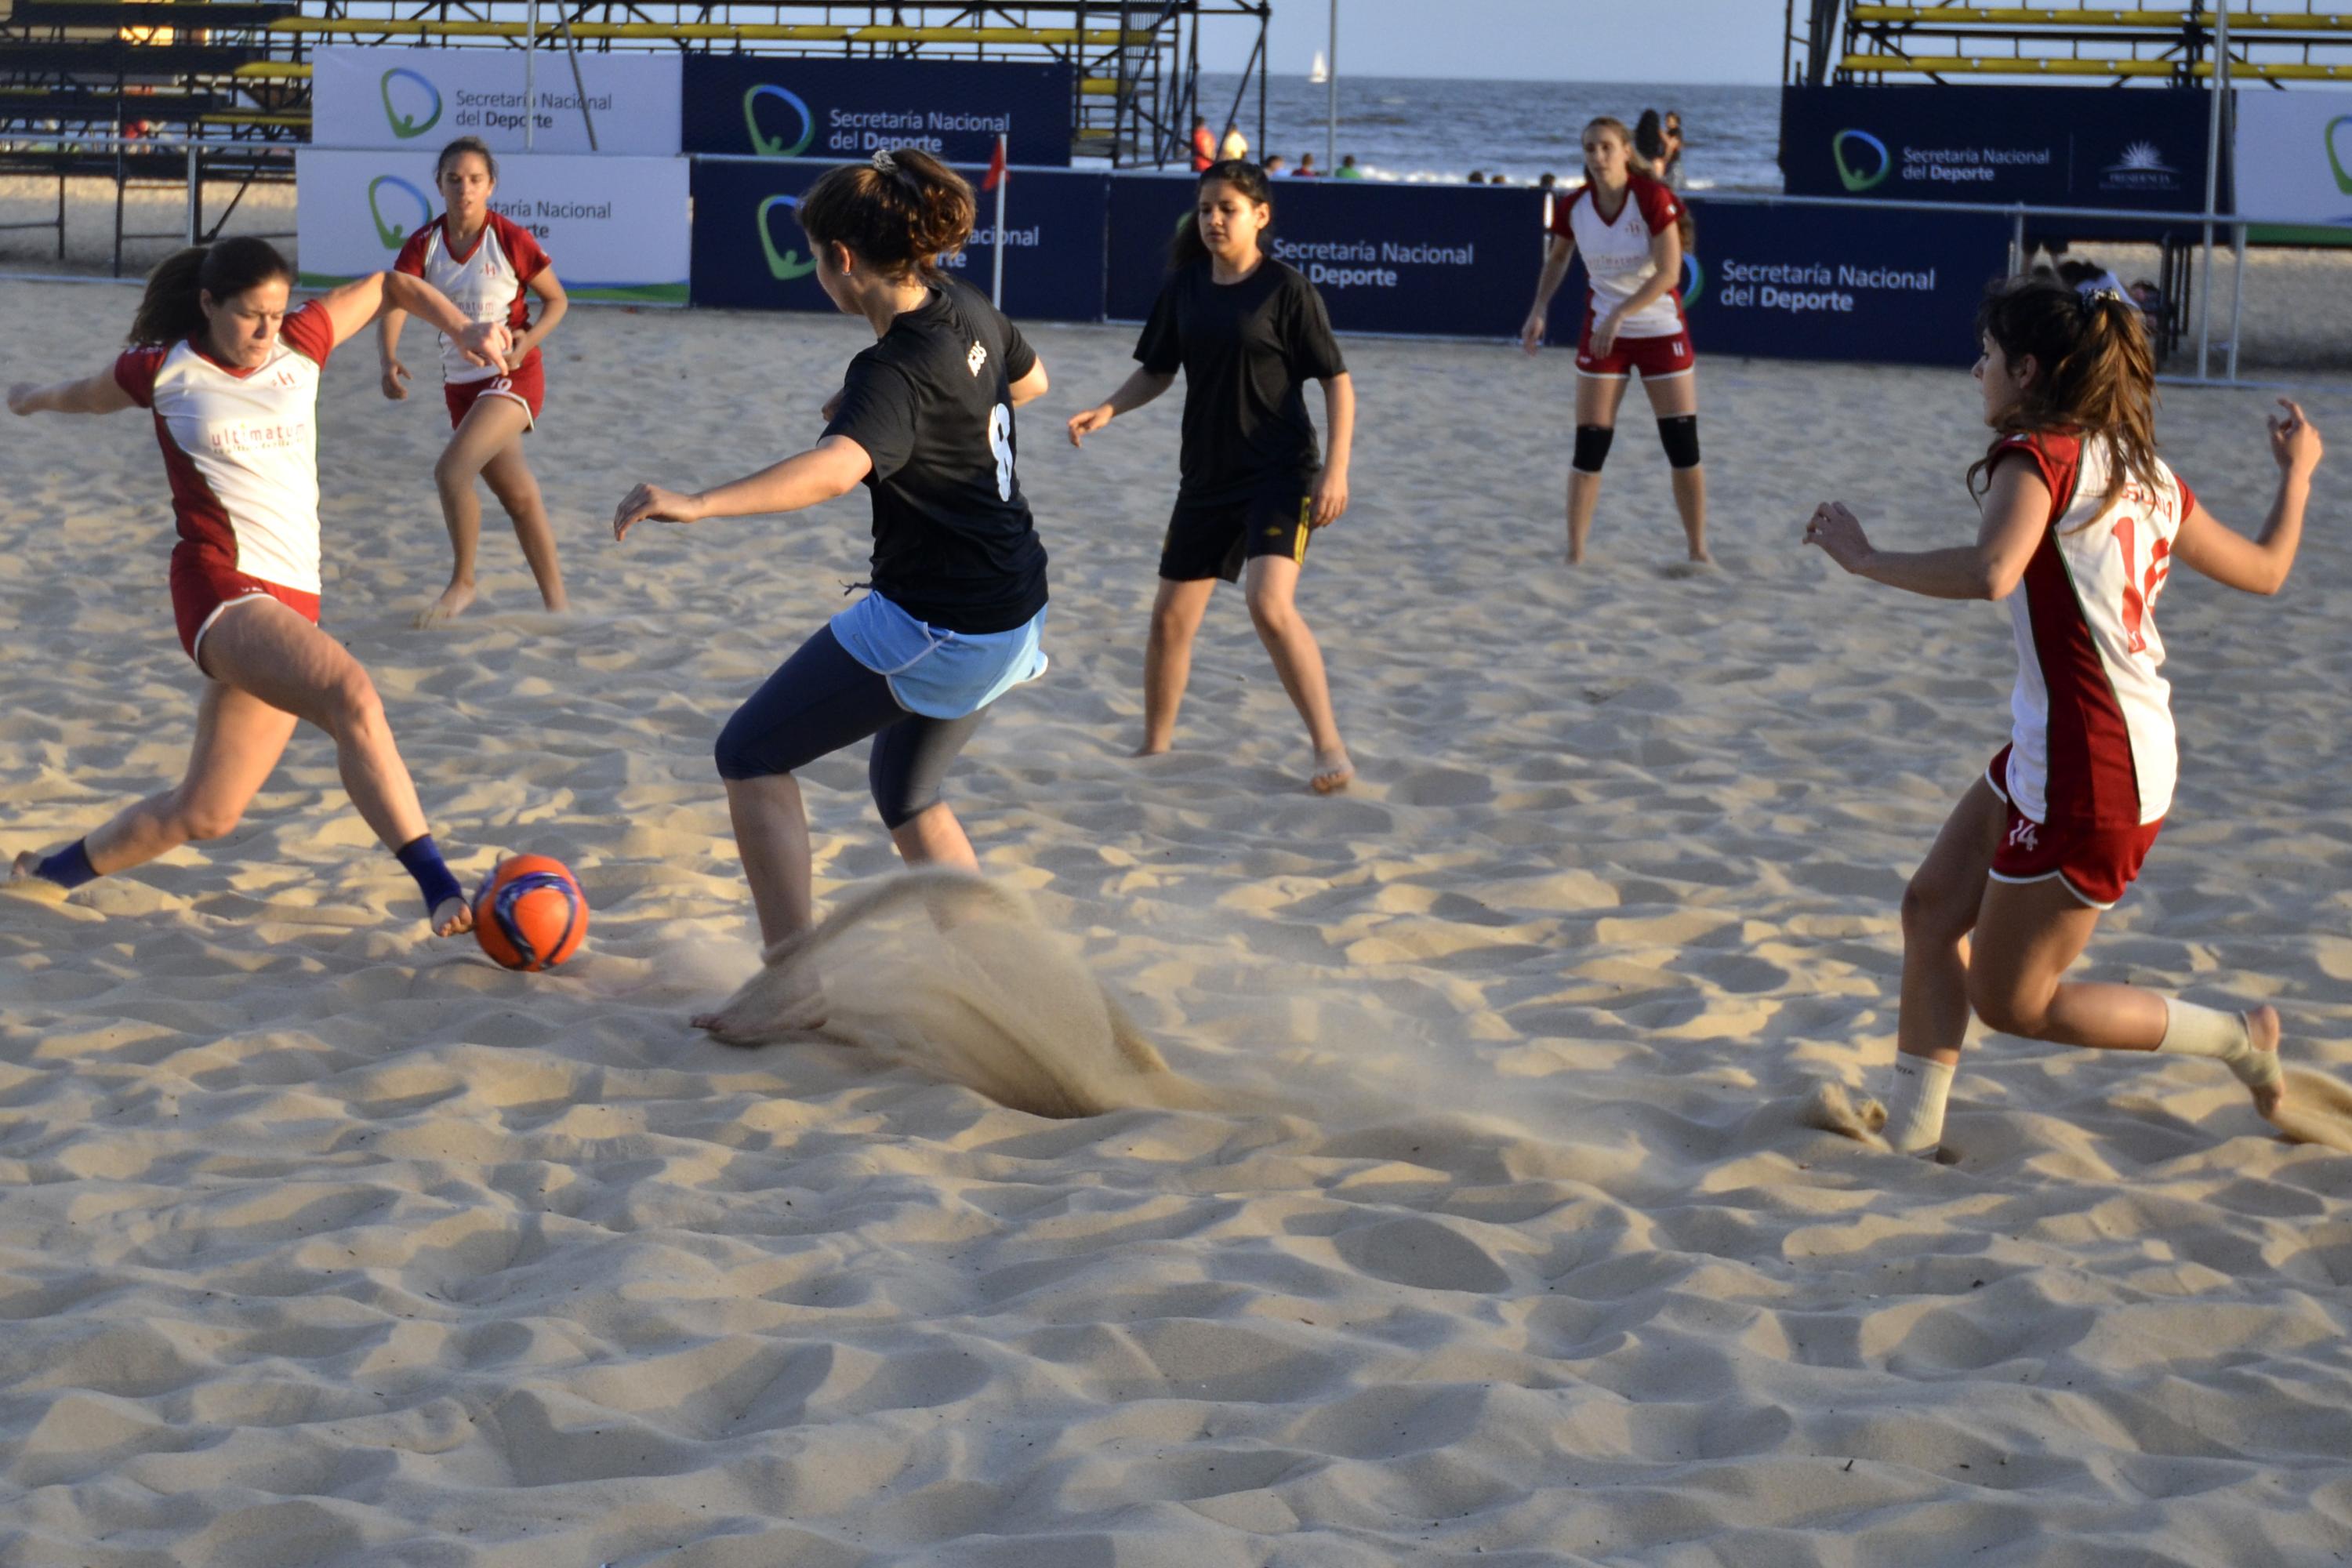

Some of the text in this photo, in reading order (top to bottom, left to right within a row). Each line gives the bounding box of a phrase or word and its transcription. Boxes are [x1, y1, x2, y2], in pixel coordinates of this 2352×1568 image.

[456, 110, 480, 125] del
[829, 109, 1010, 132] Secretaría Nacional
[829, 131, 942, 152] del Deporte
[1903, 146, 2049, 164] Secretaría Nacional
[1903, 165, 1994, 183] del Deporte
[537, 201, 612, 219] Nacional
[1272, 238, 1474, 264] Secretaría Nacional
[1309, 263, 1397, 289] Deporte
[1722, 259, 1935, 290] Secretaría Nacional
[1720, 285, 1853, 313] del Deporte
[490, 377, 513, 392] 10
[2009, 819, 2038, 851] 14
